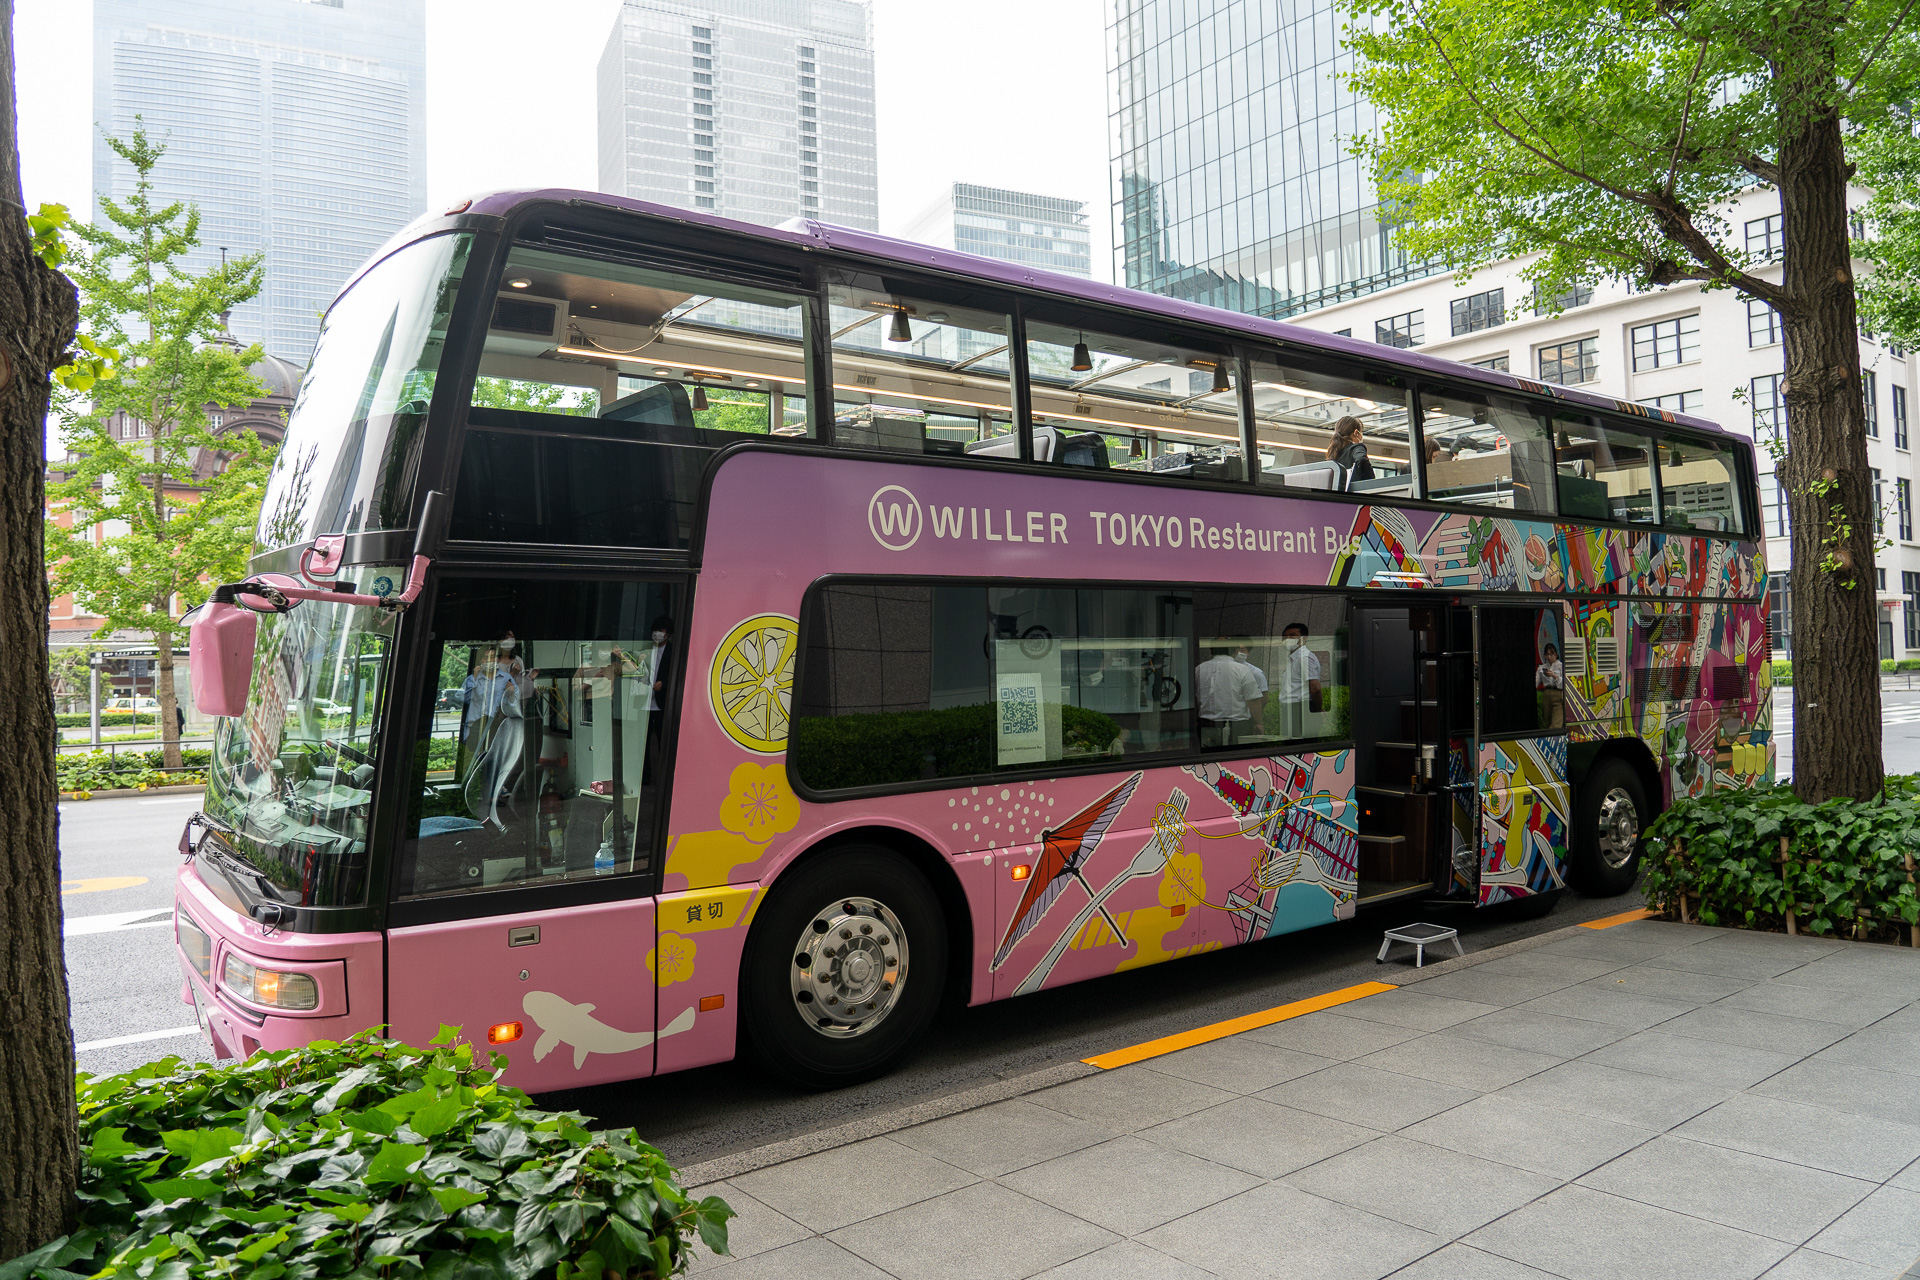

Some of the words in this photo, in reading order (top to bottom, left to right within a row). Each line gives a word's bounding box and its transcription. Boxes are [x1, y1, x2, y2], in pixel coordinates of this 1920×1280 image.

[929, 504, 1069, 545] WILLER
[1089, 511, 1183, 548] TOKYO
[1189, 517, 1317, 554] Restaurant
[1323, 525, 1363, 556] Bus
[1705, 544, 1722, 606] WILLE
[686, 901, 723, 925] 貸切
